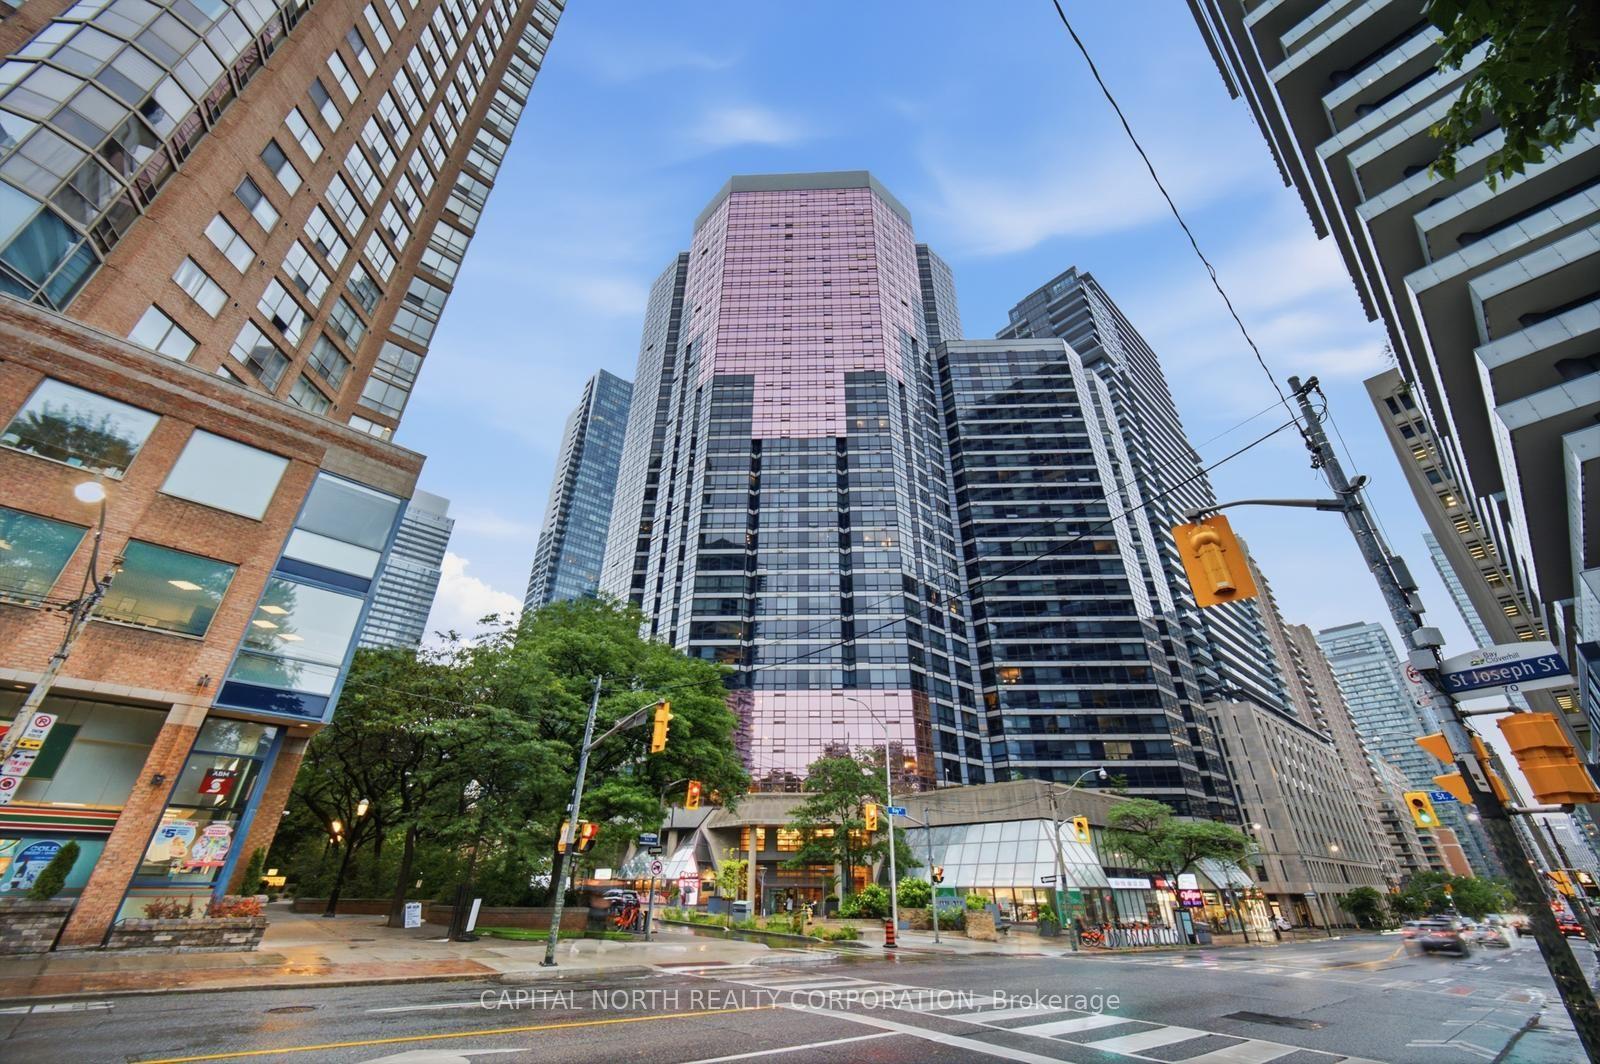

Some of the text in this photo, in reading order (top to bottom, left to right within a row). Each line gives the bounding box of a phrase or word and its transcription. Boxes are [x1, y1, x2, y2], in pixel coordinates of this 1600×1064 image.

[1482, 651, 1498, 659] Bay
[1485, 651, 1520, 663] Cloverhill
[1450, 657, 1560, 687] St Joseph St
[1502, 684, 1519, 693] 70
